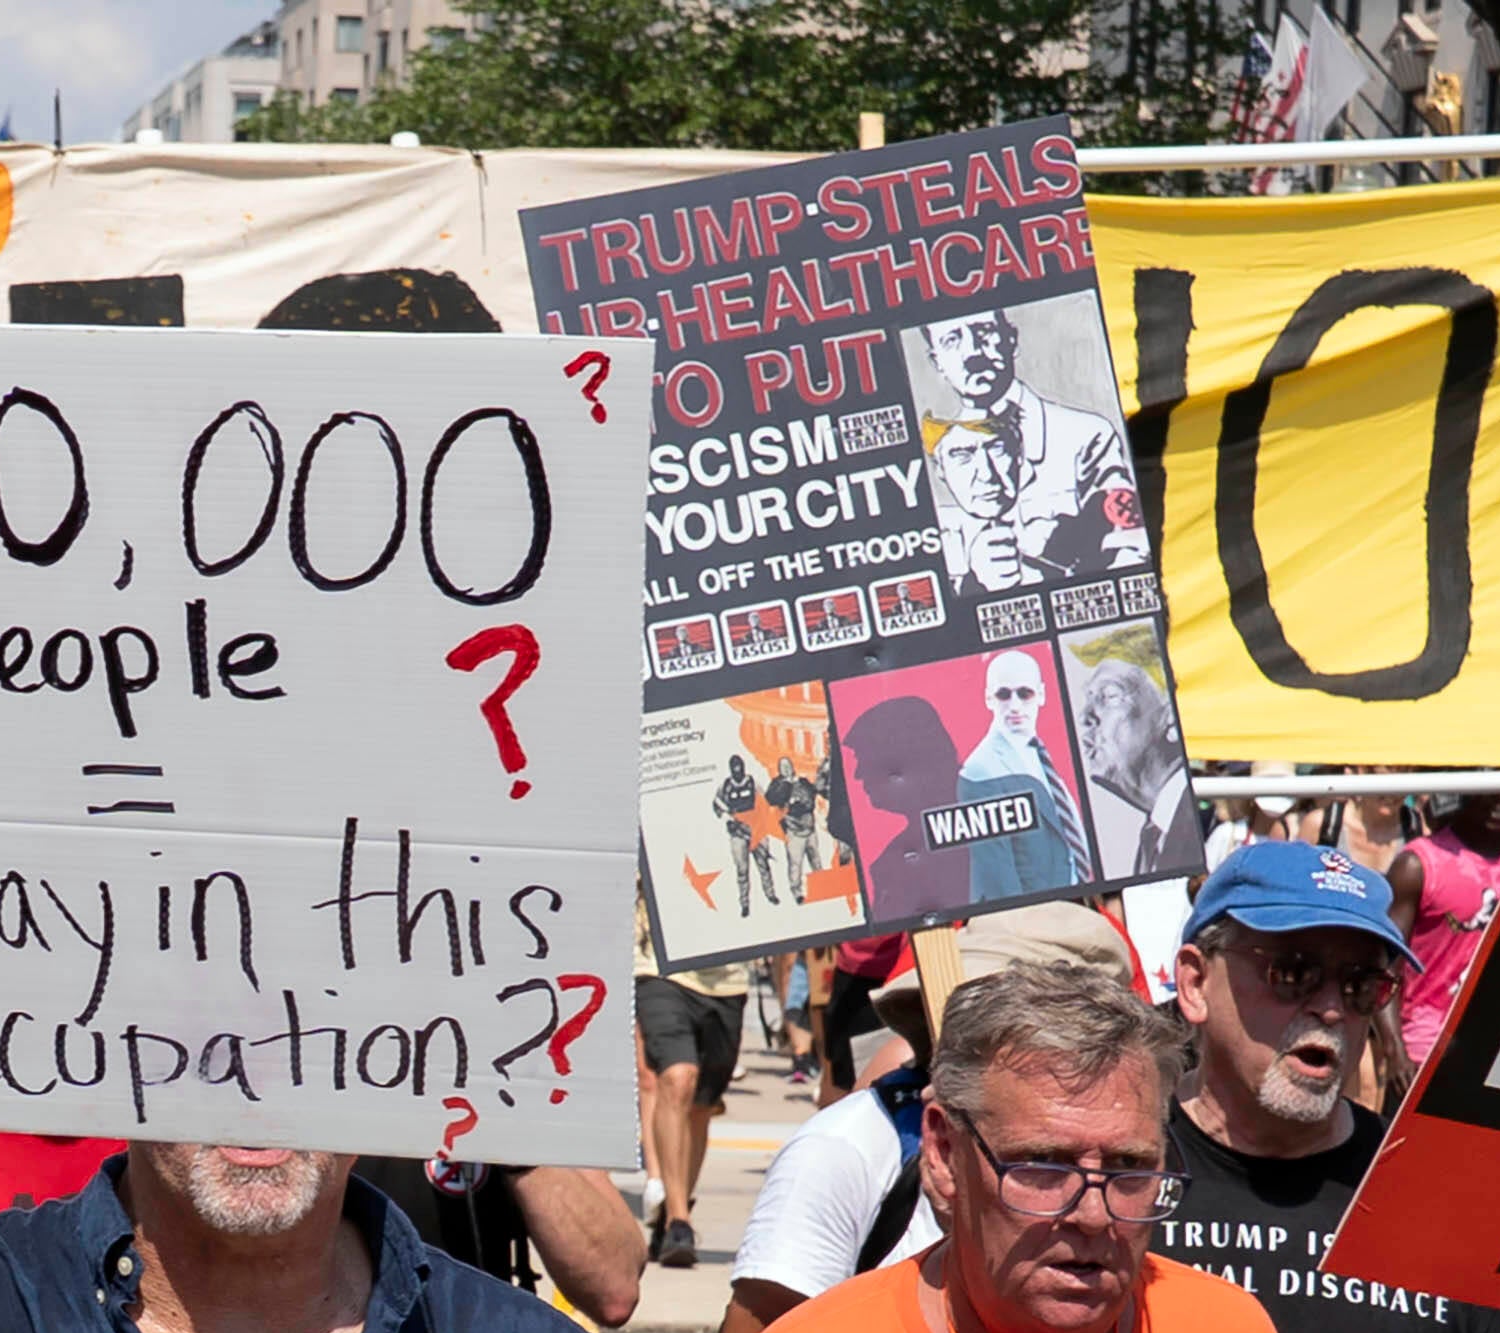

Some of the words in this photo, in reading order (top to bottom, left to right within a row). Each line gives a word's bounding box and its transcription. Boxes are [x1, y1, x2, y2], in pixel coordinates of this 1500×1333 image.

[539, 192, 802, 293] TRUMP
[819, 136, 1083, 243] STEALS
[666, 211, 1094, 351] HEALTHCARE
[748, 331, 885, 415] PUT
[842, 407, 901, 429] TRUMP
[847, 430, 906, 453] TRAITOR
[647, 418, 839, 496] SCISM
[645, 489, 788, 555] YOUR
[795, 459, 924, 525] CITY
[698, 558, 755, 593] OFF
[763, 546, 824, 583] THE
[828, 527, 942, 569] TROOPS
[1054, 583, 1113, 604] TRUMP
[1123, 574, 1157, 592] TRU
[980, 597, 1039, 619] TRUMP
[1127, 596, 1159, 615] TRAI
[882, 612, 939, 630] FASCIST
[1057, 606, 1117, 629] TRAITOR
[807, 626, 865, 645] FASCIST
[984, 620, 1043, 643] TRAITOR
[733, 640, 791, 660] FASCIST
[660, 653, 718, 673] FASCIST
[445, 623, 541, 800] ?
[641, 730, 705, 749] emocracy
[928, 795, 1034, 847] WANTED
[150, 851, 260, 991] in
[312, 817, 563, 977] this
[1161, 1220, 1287, 1252] TRUMP
[1280, 1268, 1449, 1325] DISGRACE
